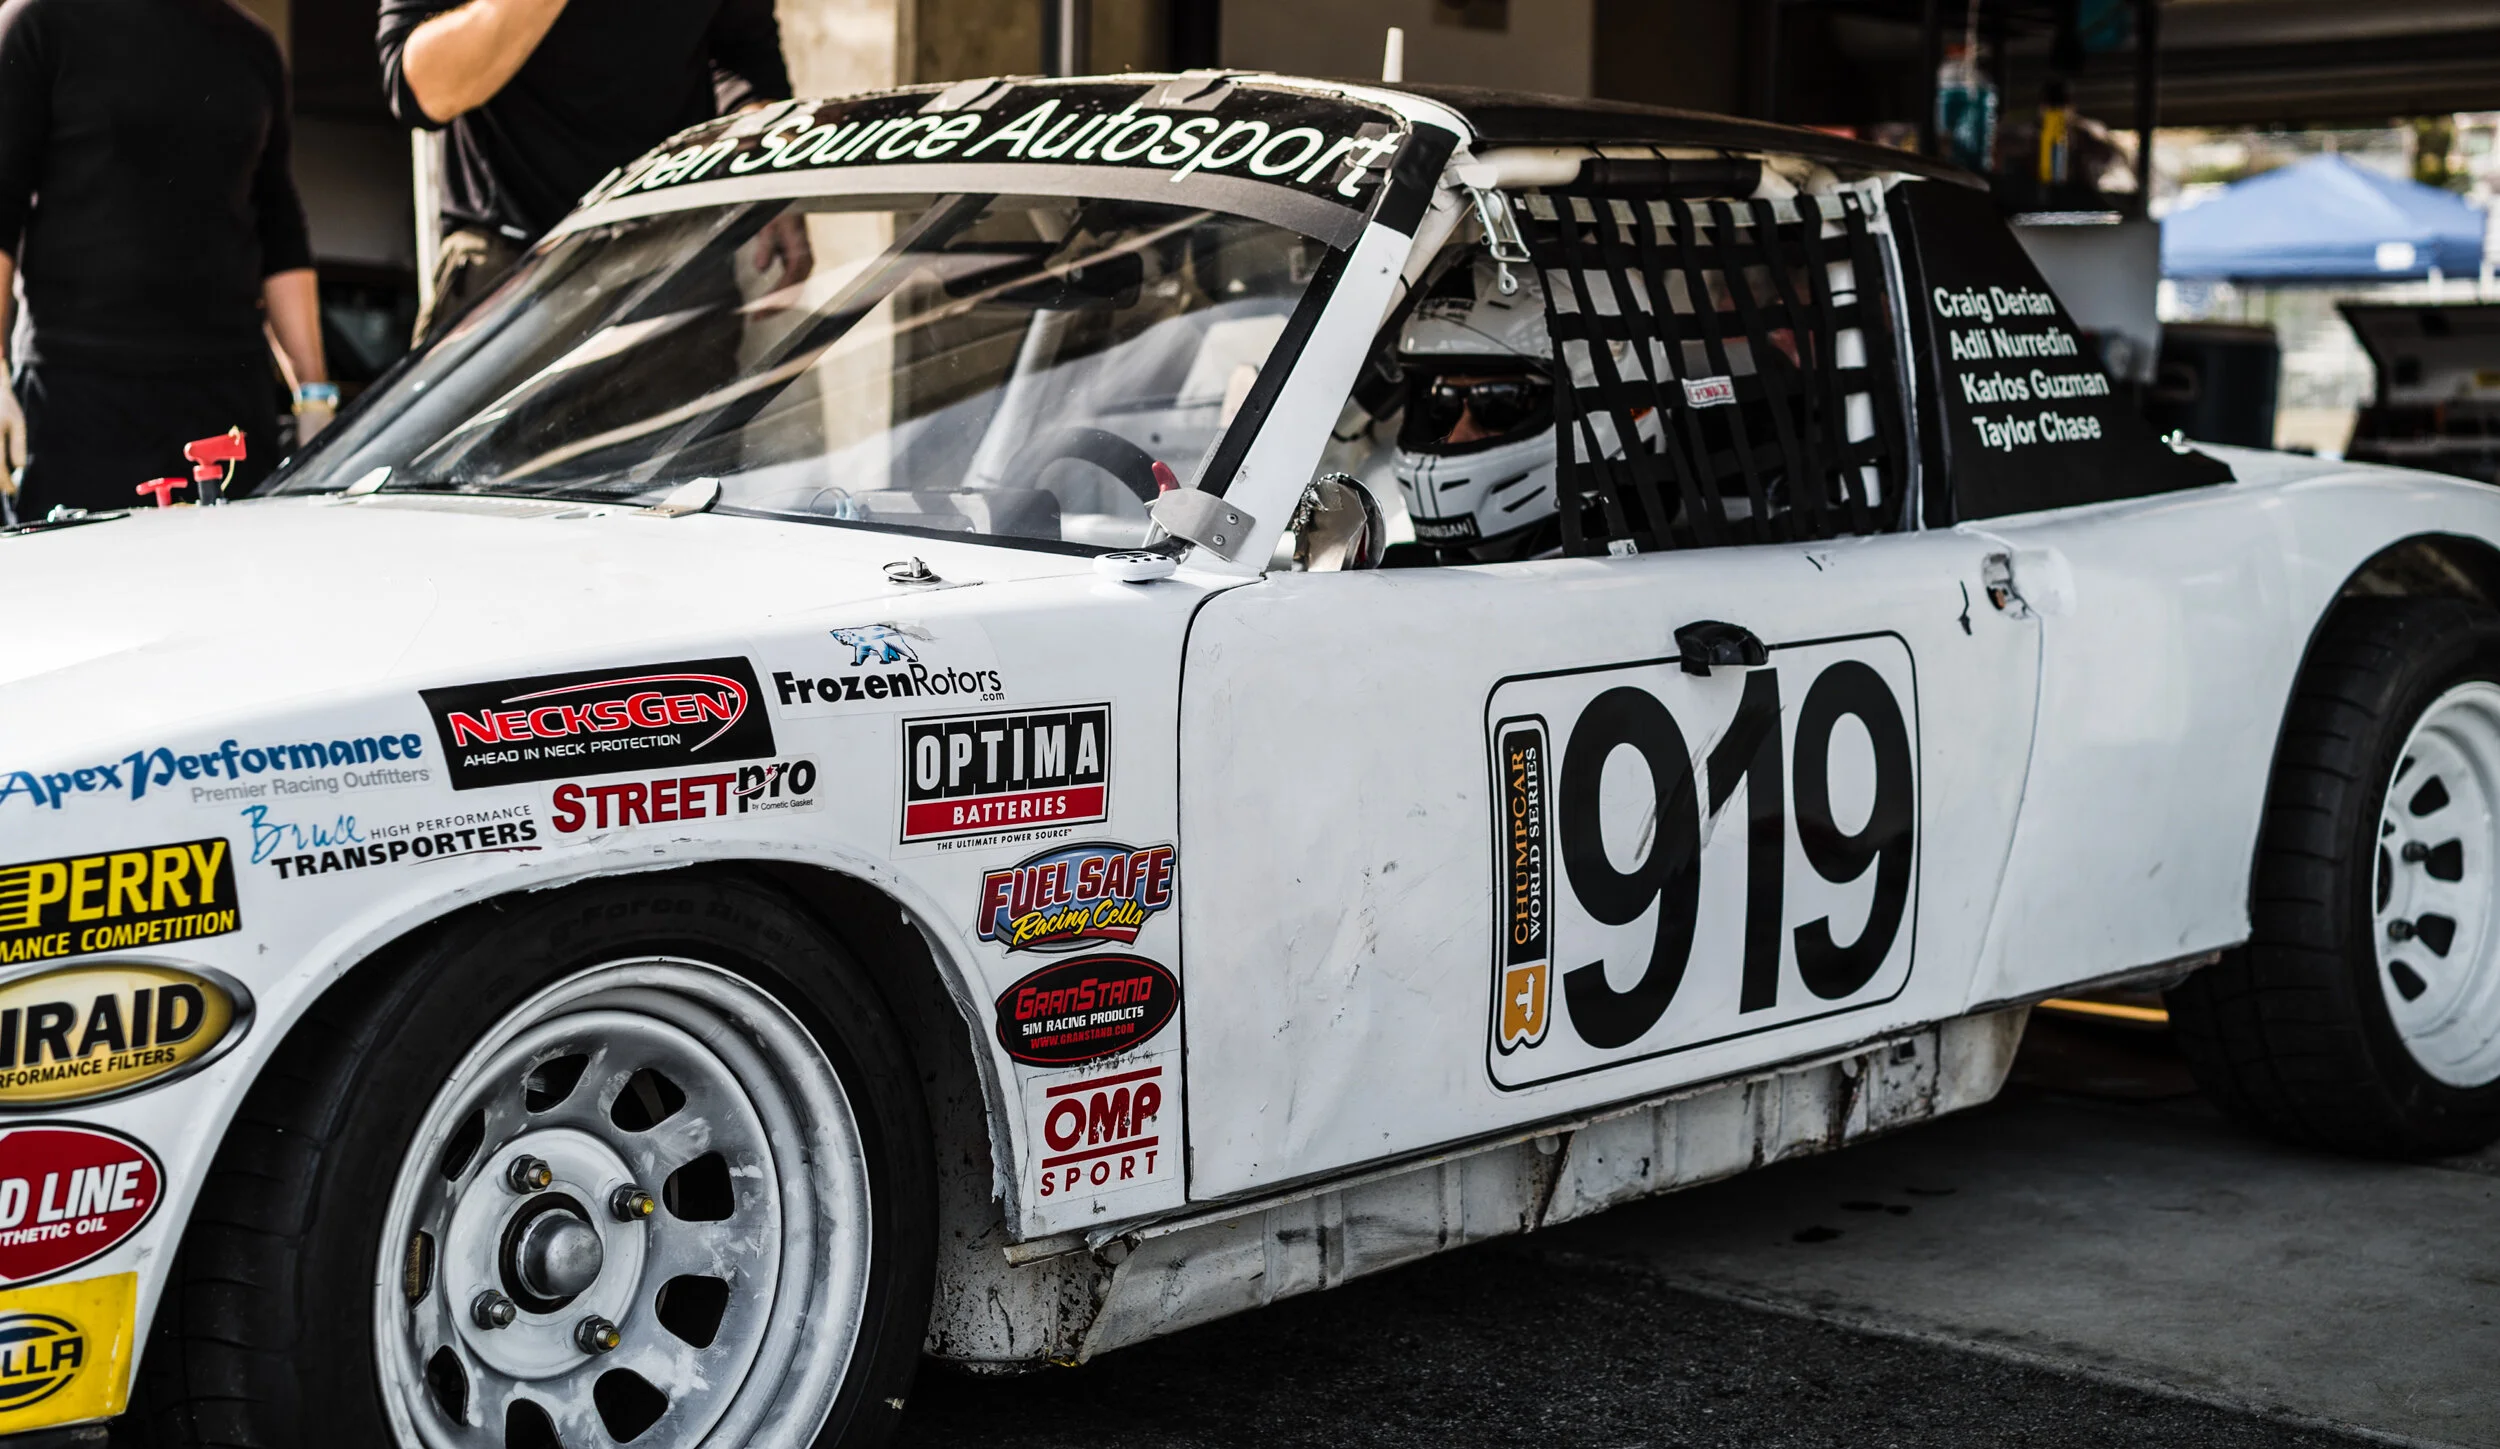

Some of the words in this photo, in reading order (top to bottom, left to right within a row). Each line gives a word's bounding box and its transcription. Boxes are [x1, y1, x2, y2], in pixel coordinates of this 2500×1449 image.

[731, 109, 990, 175] Source
[983, 97, 1402, 200] Autosport
[1933, 286, 1994, 323] Craig
[1990, 286, 2056, 316] Derian
[1950, 327, 1993, 361] Adli
[1990, 326, 2078, 357] Nurredin
[1960, 371, 2030, 404] Karlos
[2029, 368, 2110, 399] Guzman
[1971, 414, 2037, 452] Taylor
[2038, 411, 2102, 443] Chase
[772, 663, 1002, 706] FrozenRotors
[979, 691, 1005, 701] .com
[0, 762, 123, 809] Apex
[121, 731, 423, 801] Performance
[463, 751, 520, 768] AHEAD
[523, 748, 541, 761] IN
[544, 743, 587, 759] NECK
[589, 733, 681, 754] PROTECTION
[915, 722, 1100, 791] OPTIMA
[191, 780, 268, 804] Premier
[272, 772, 340, 798] Racing
[344, 766, 431, 791] Outfitters
[761, 800, 789, 811] Cometic
[790, 798, 813, 808] Gasket
[1525, 746, 1540, 838] SERIES
[370, 822, 413, 840] HIGH
[416, 804, 533, 834] PERFORMANCE
[952, 795, 1068, 826] BATTERIES
[271, 819, 539, 881] TRANSPORTERS
[936, 841, 953, 851] THE
[956, 836, 998, 849] ULTIMATE
[1001, 832, 1033, 844] POWER
[1035, 829, 1069, 840] SOURCE
[1511, 747, 1529, 946] CHUMPCAR
[1558, 659, 1914, 1050] 919
[24, 841, 227, 928] PERRY
[978, 859, 1073, 936] FUEL
[1075, 846, 1174, 907] SAFE
[1529, 844, 1542, 941] WORLD
[80, 909, 235, 952] COMPETITION
[1010, 906, 1091, 946] Racing
[1092, 898, 1144, 929] Cells
[1022, 1022, 1042, 1035] SIM
[1046, 1014, 1086, 1033] RACING
[1090, 1005, 1144, 1026] PRODUCTS
[1030, 1022, 1135, 1049] WWW.GRANSTAND.COM
[107, 1047, 176, 1072] FILTERS
[1044, 1081, 1162, 1152] OMP
[1040, 1150, 1158, 1197] SPORT
[75, 1216, 108, 1236] OIL
